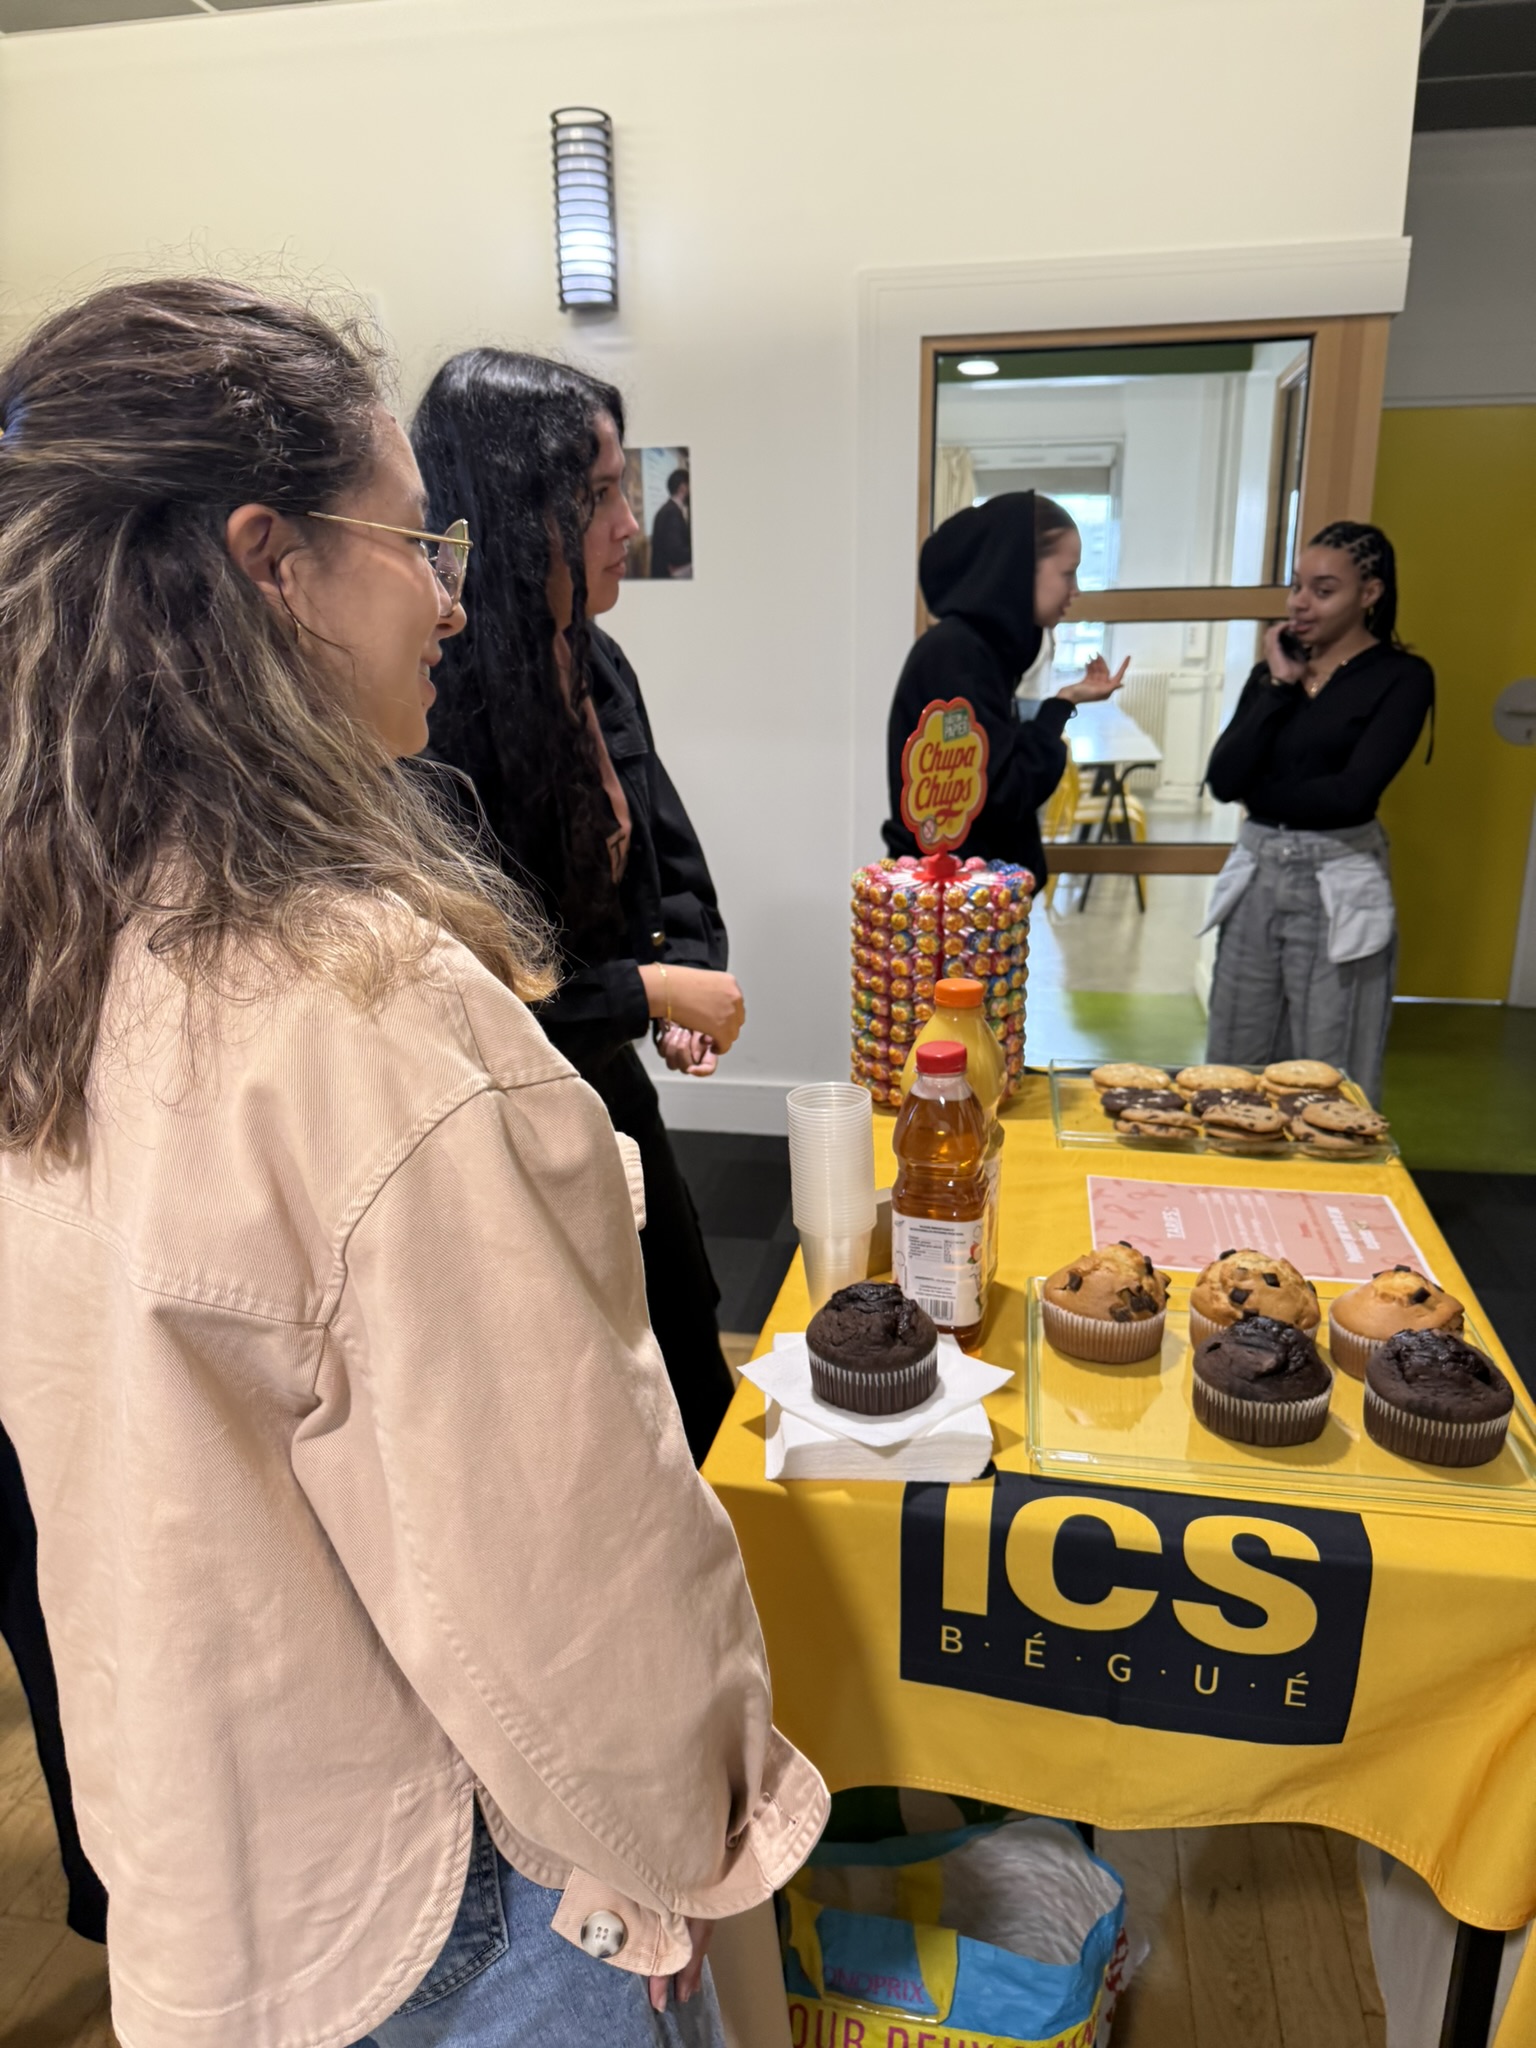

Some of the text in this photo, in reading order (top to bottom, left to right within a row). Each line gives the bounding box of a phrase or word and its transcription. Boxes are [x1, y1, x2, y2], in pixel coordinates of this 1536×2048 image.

[919, 741, 977, 777] Chupa
[915, 776, 972, 813] Chups
[942, 1478, 1321, 1655] ICS
[823, 1966, 924, 2004] ONOPRIX
[789, 2003, 866, 2048] OUR
